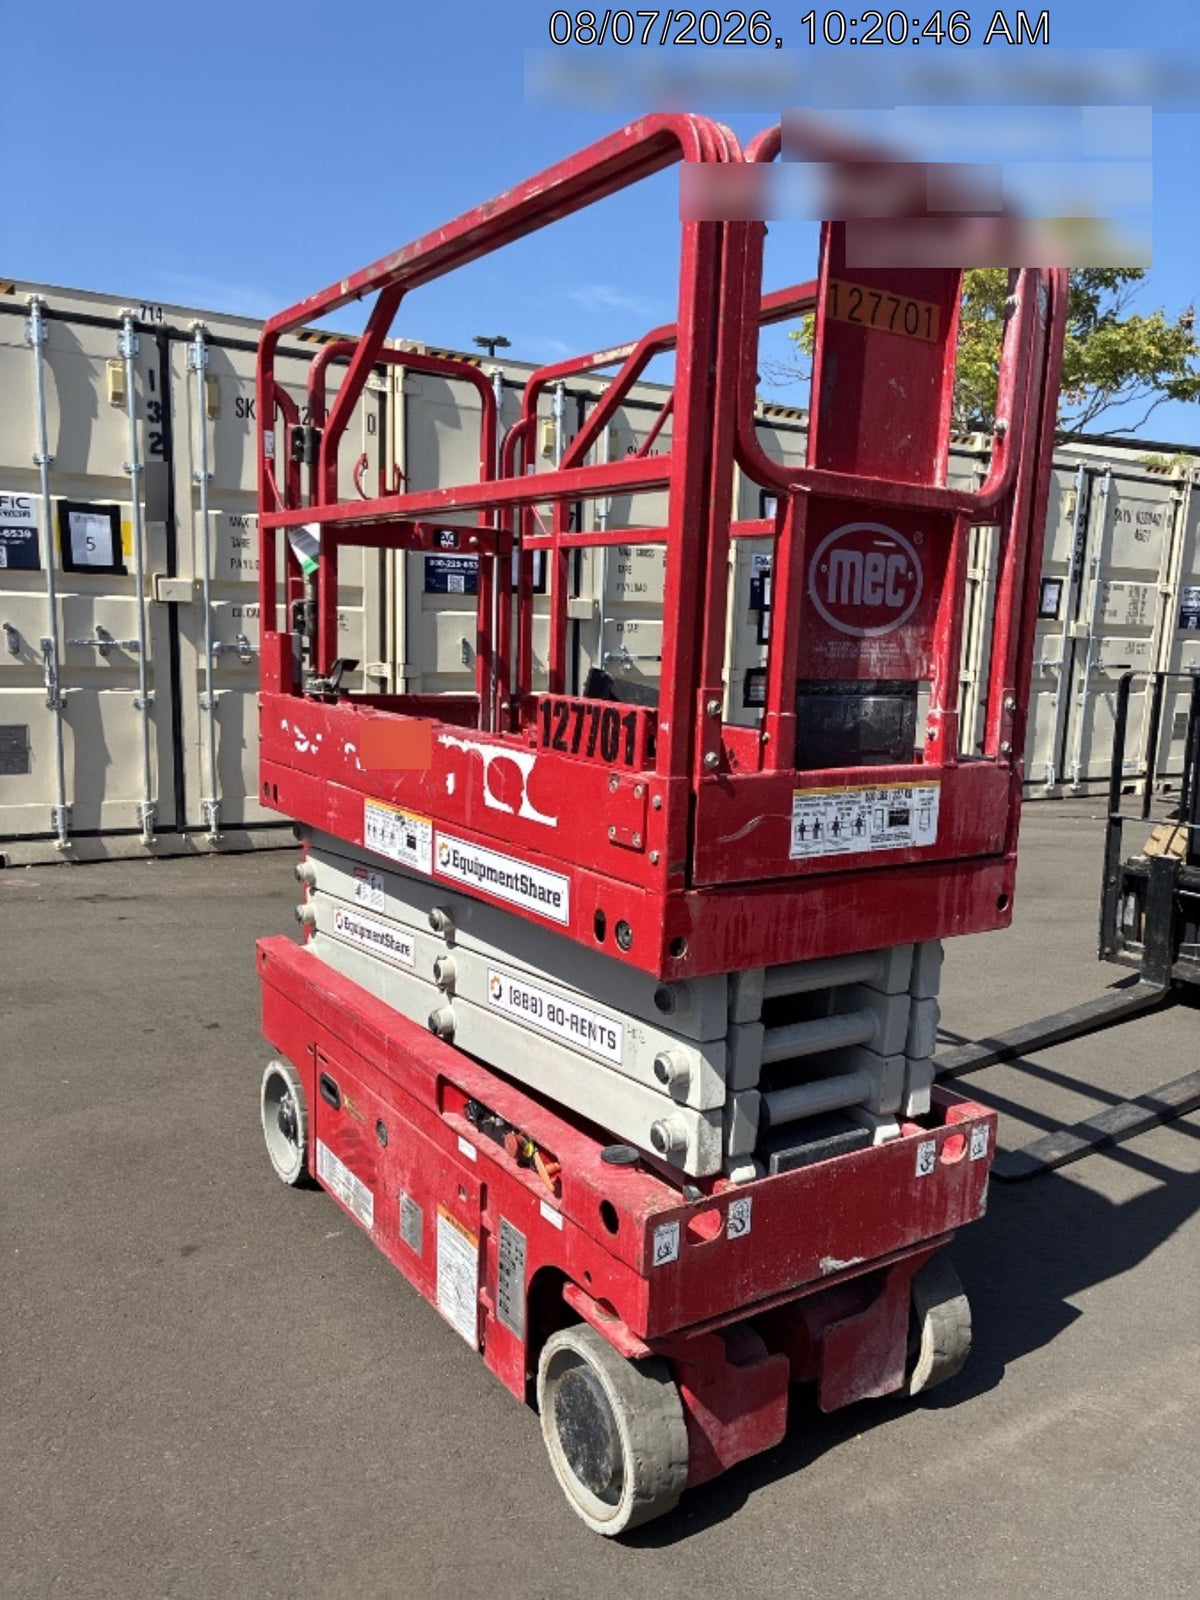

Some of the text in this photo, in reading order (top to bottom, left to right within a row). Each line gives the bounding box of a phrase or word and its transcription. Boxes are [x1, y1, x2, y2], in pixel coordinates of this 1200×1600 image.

[139, 304, 163, 322] 714
[829, 283, 933, 339] 127701
[86, 536, 97, 552] 5
[540, 698, 638, 768] 127701
[452, 849, 562, 908] EquipmentShare
[509, 985, 617, 1050] (888) 80-RENTS
